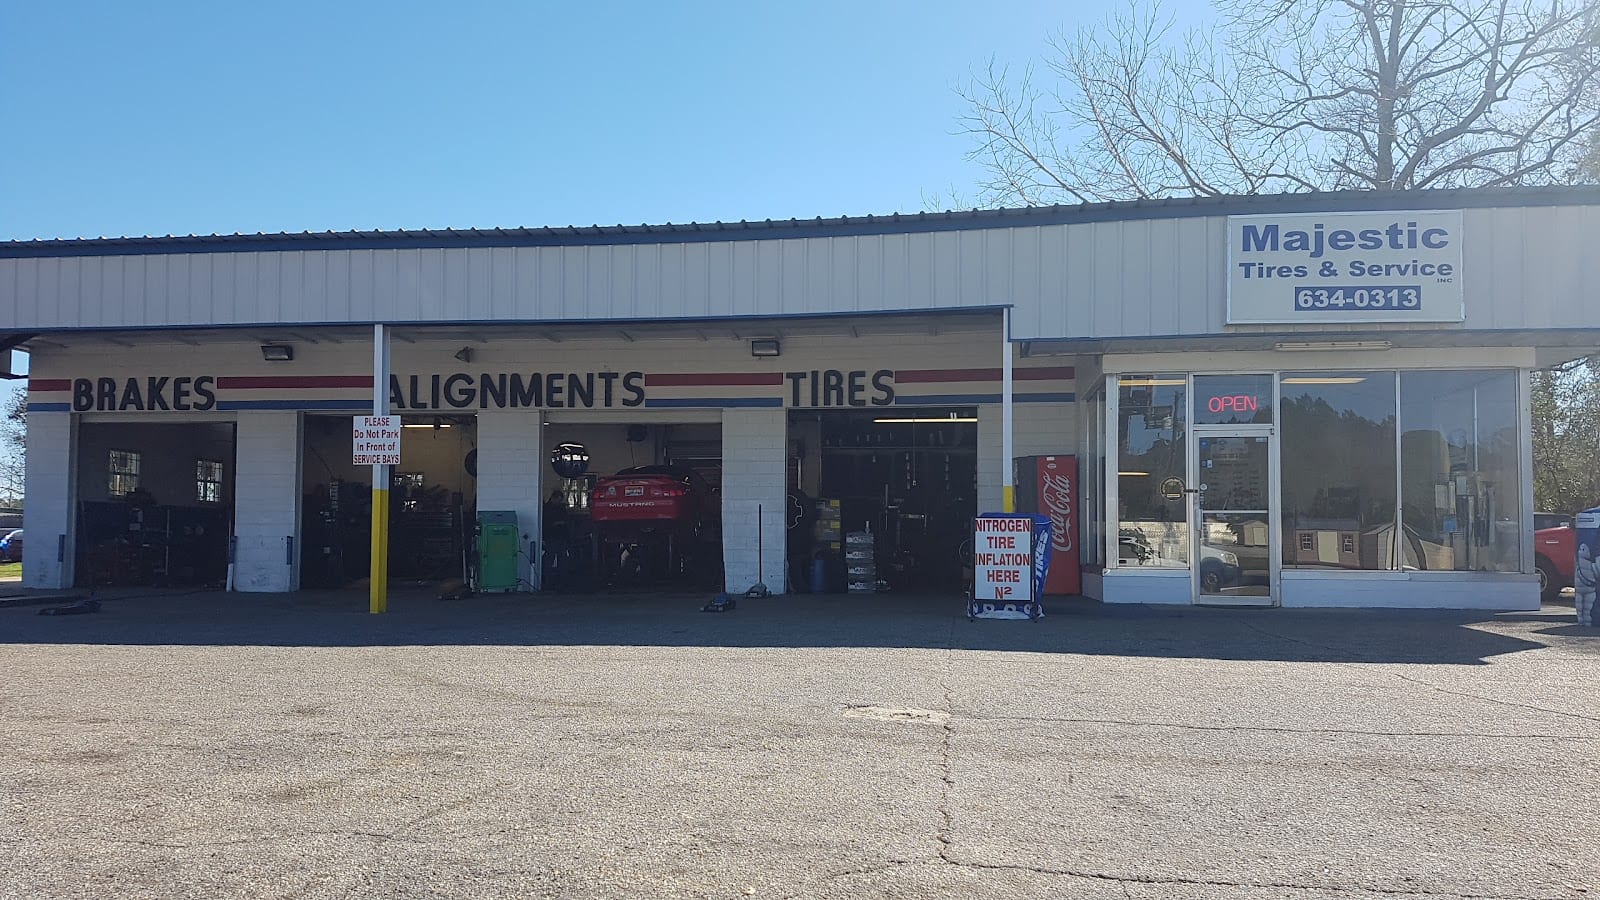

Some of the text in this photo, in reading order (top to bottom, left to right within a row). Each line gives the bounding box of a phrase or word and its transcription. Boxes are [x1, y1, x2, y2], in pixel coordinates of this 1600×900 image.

[1241, 222, 1449, 258] Majestic
[1238, 259, 1453, 279] Tires & Service
[1297, 288, 1418, 308] 634-0313
[73, 376, 217, 412] BRAKES
[786, 369, 895, 406] TIRES
[1208, 396, 1257, 412] OPEN
[364, 417, 390, 426] PLEASE
[354, 429, 399, 439] Do Not Park
[366, 442, 386, 451] Front
[388, 442, 396, 451] of
[353, 454, 400, 464] SERVICE BAYS
[975, 519, 1030, 532] NITROGEN
[987, 536, 1016, 549] TIRE
[975, 553, 1030, 566] INFLATION
[987, 570, 1020, 583] HERE
